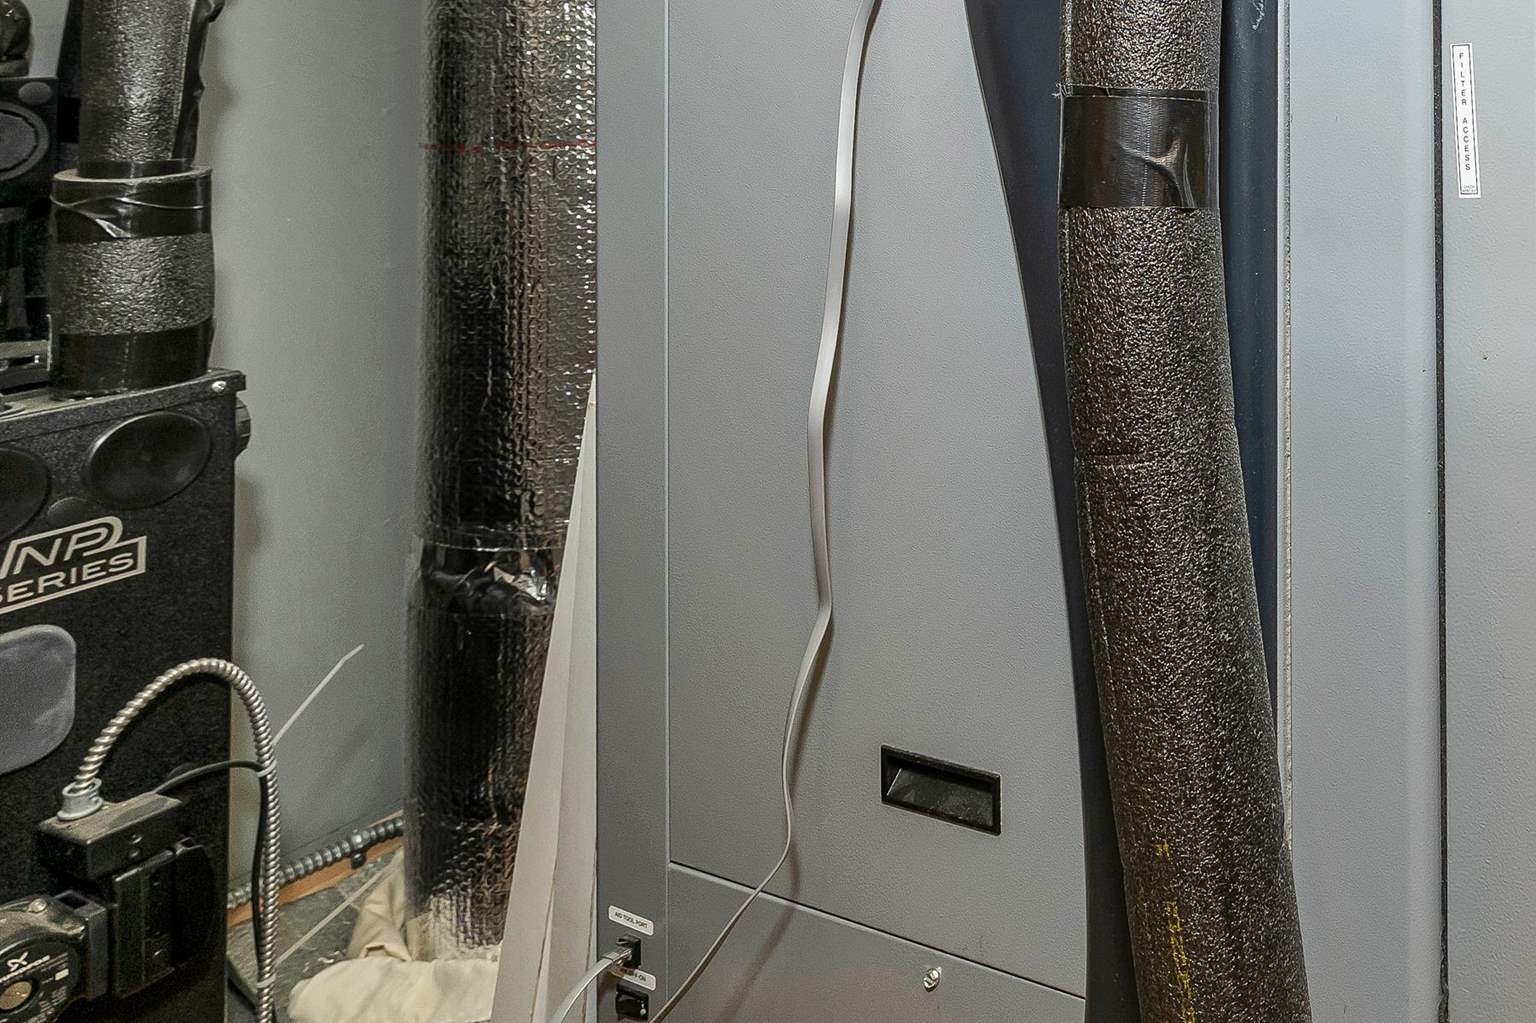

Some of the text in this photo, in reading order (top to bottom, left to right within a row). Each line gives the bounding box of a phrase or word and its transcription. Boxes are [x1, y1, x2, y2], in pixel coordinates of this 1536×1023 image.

[1458, 52, 1471, 171] FILTER ACCESS
[13, 527, 109, 575] NP
[0, 552, 135, 603] ERIES
